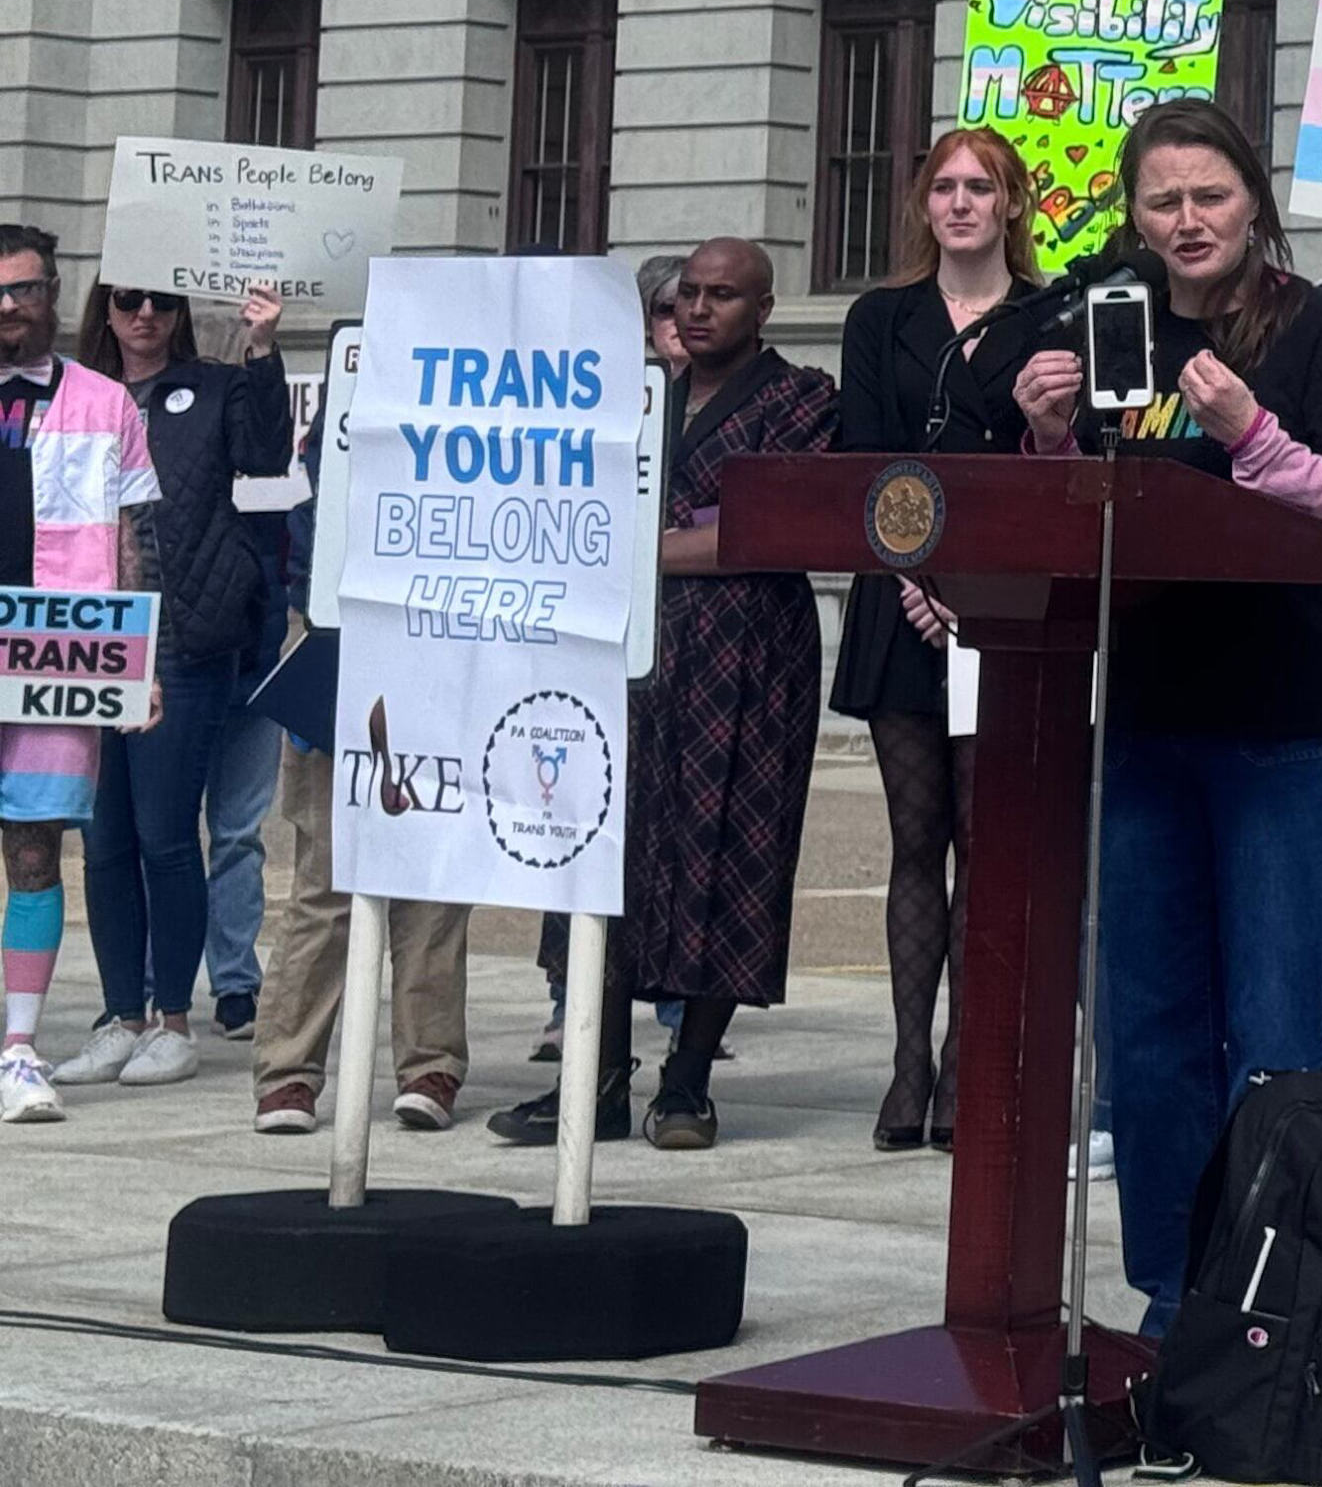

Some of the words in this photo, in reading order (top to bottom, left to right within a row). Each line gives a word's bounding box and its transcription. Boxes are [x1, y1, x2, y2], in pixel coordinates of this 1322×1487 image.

[136, 152, 224, 184] TRANS
[237, 157, 297, 190] People
[309, 163, 375, 192] Belong
[173, 268, 325, 297] EVERYERE
[412, 347, 602, 410] TRANS
[399, 422, 596, 488] YOUTH
[374, 492, 611, 568] BELONG
[405, 575, 567, 645] HERE
[22, 683, 125, 720] KIDS
[511, 725, 526, 739] PA
[530, 726, 586, 743] COALITION
[512, 821, 546, 837] TRANS
[550, 824, 578, 840] YOUTH
